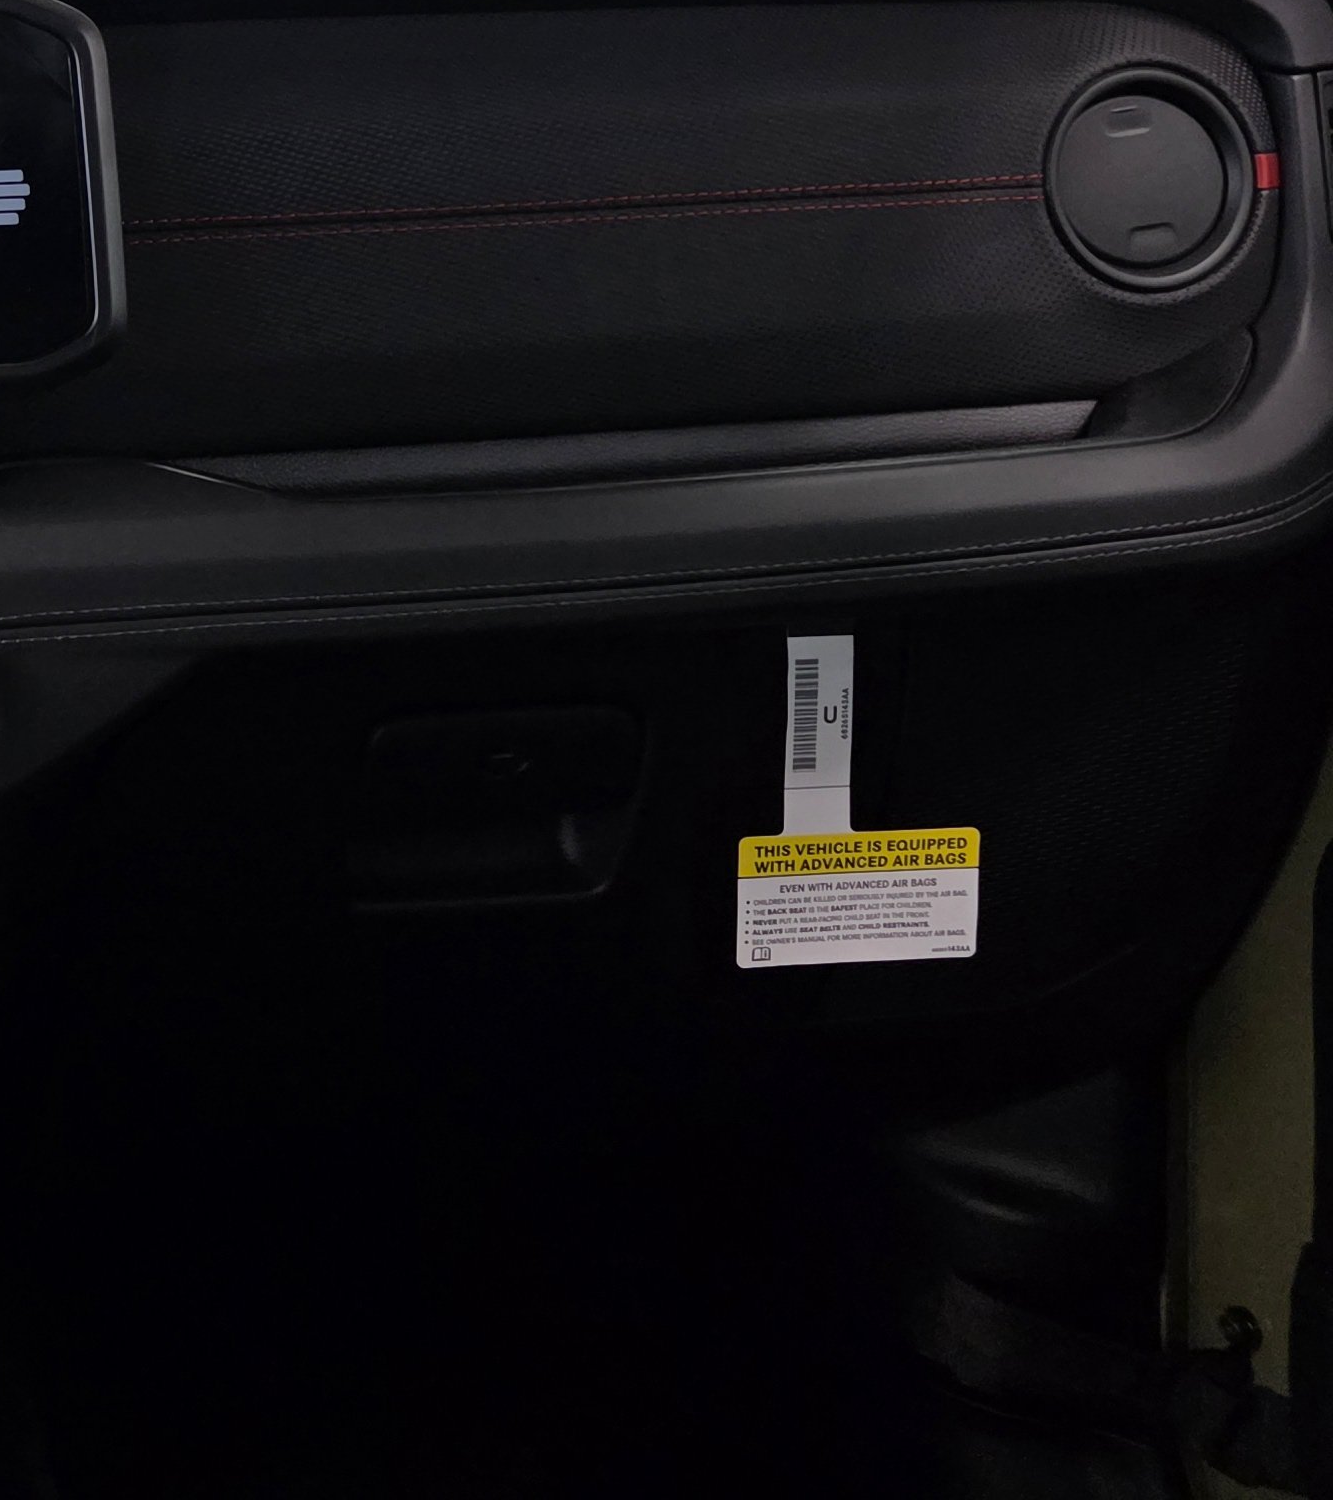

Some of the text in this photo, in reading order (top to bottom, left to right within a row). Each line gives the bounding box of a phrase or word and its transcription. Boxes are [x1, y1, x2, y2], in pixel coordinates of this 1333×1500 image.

[754, 837, 968, 859] THIS VEHICLE IS EQUIPPED
[755, 852, 967, 874] WITH ADVANCED AIR BAGS
[779, 877, 937, 894] EVEN WITH ADVANCED AIR BAGS
